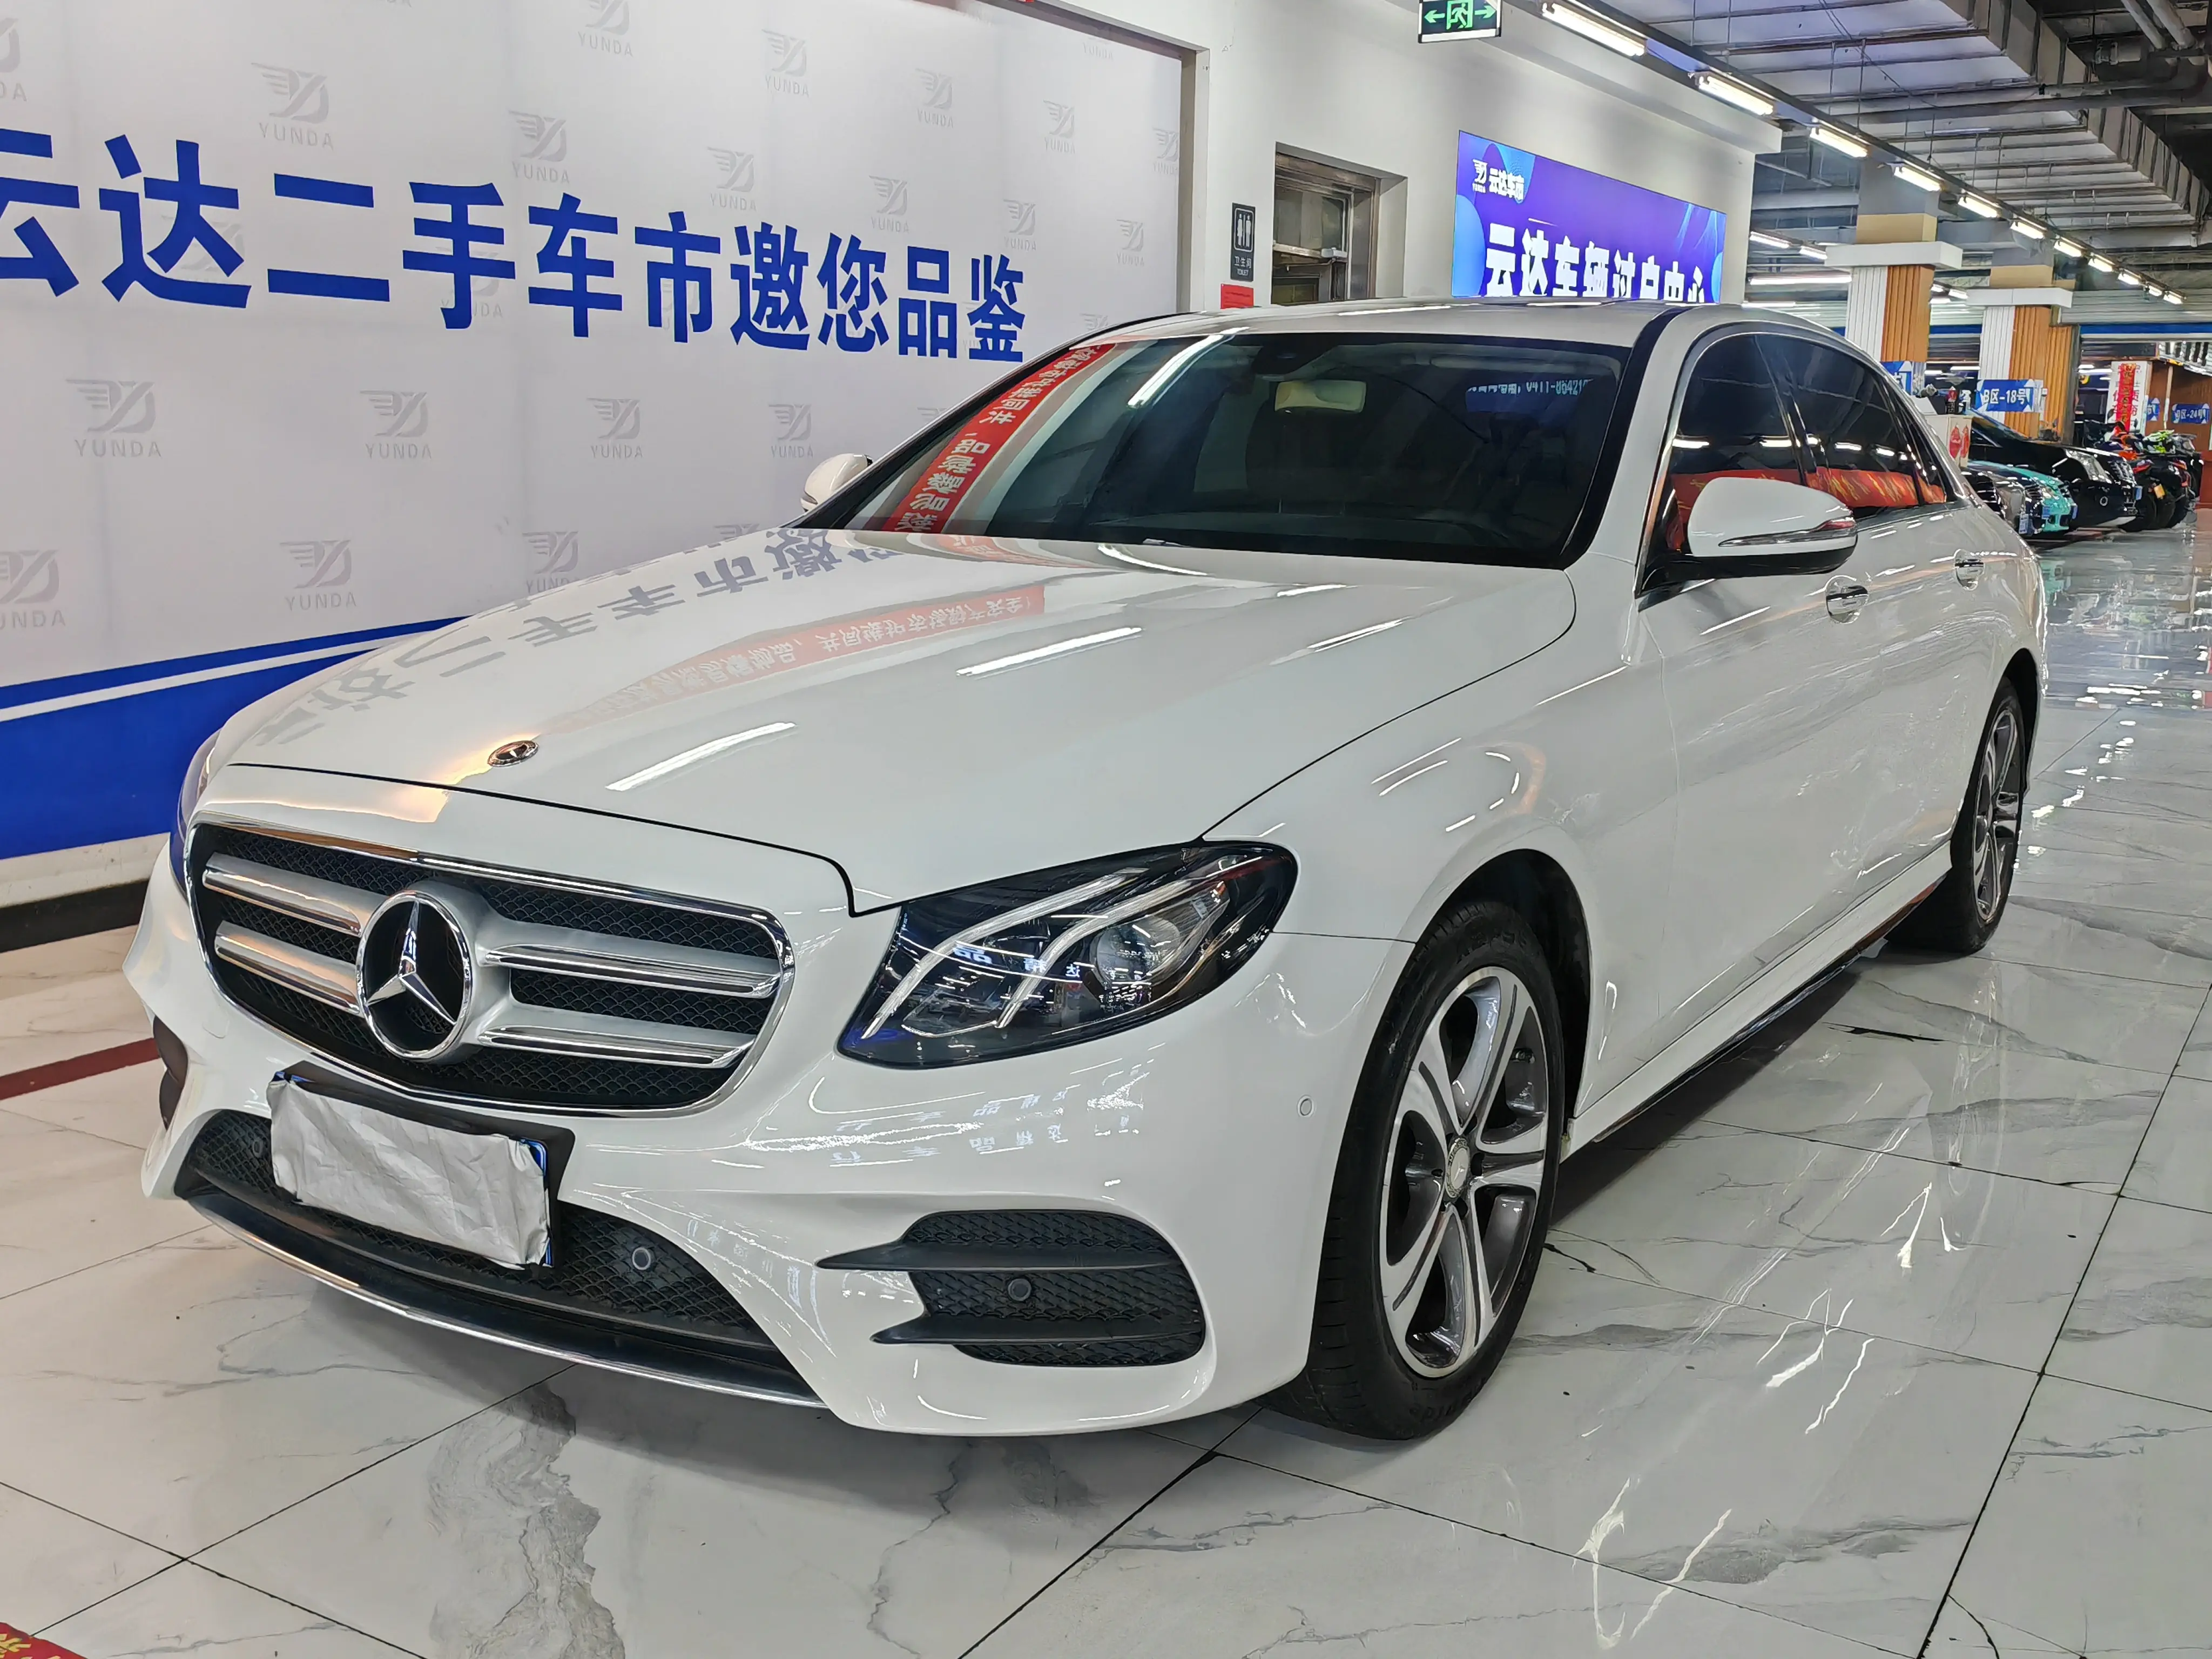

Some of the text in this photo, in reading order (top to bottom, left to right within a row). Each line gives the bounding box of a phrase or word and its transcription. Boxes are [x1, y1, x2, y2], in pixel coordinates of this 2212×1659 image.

[578, 31, 633, 58] YUNDA
[764, 76, 810, 98] YUNDA
[258, 121, 334, 151] YUNDA
[512, 162, 570, 184] YUNDA
[710, 193, 757, 211] YUNDA
[871, 217, 909, 234] YUNDA
[0, 129, 1024, 363] 云达二手车市邀您品鉴
[1235, 255, 1252, 269] 卫生间
[74, 439, 162, 458] YUNDA
[365, 442, 432, 460] YUNDA
[590, 444, 643, 459] YUNDA
[771, 444, 814, 459] YUNDA
[284, 592, 358, 610] YUNDA
